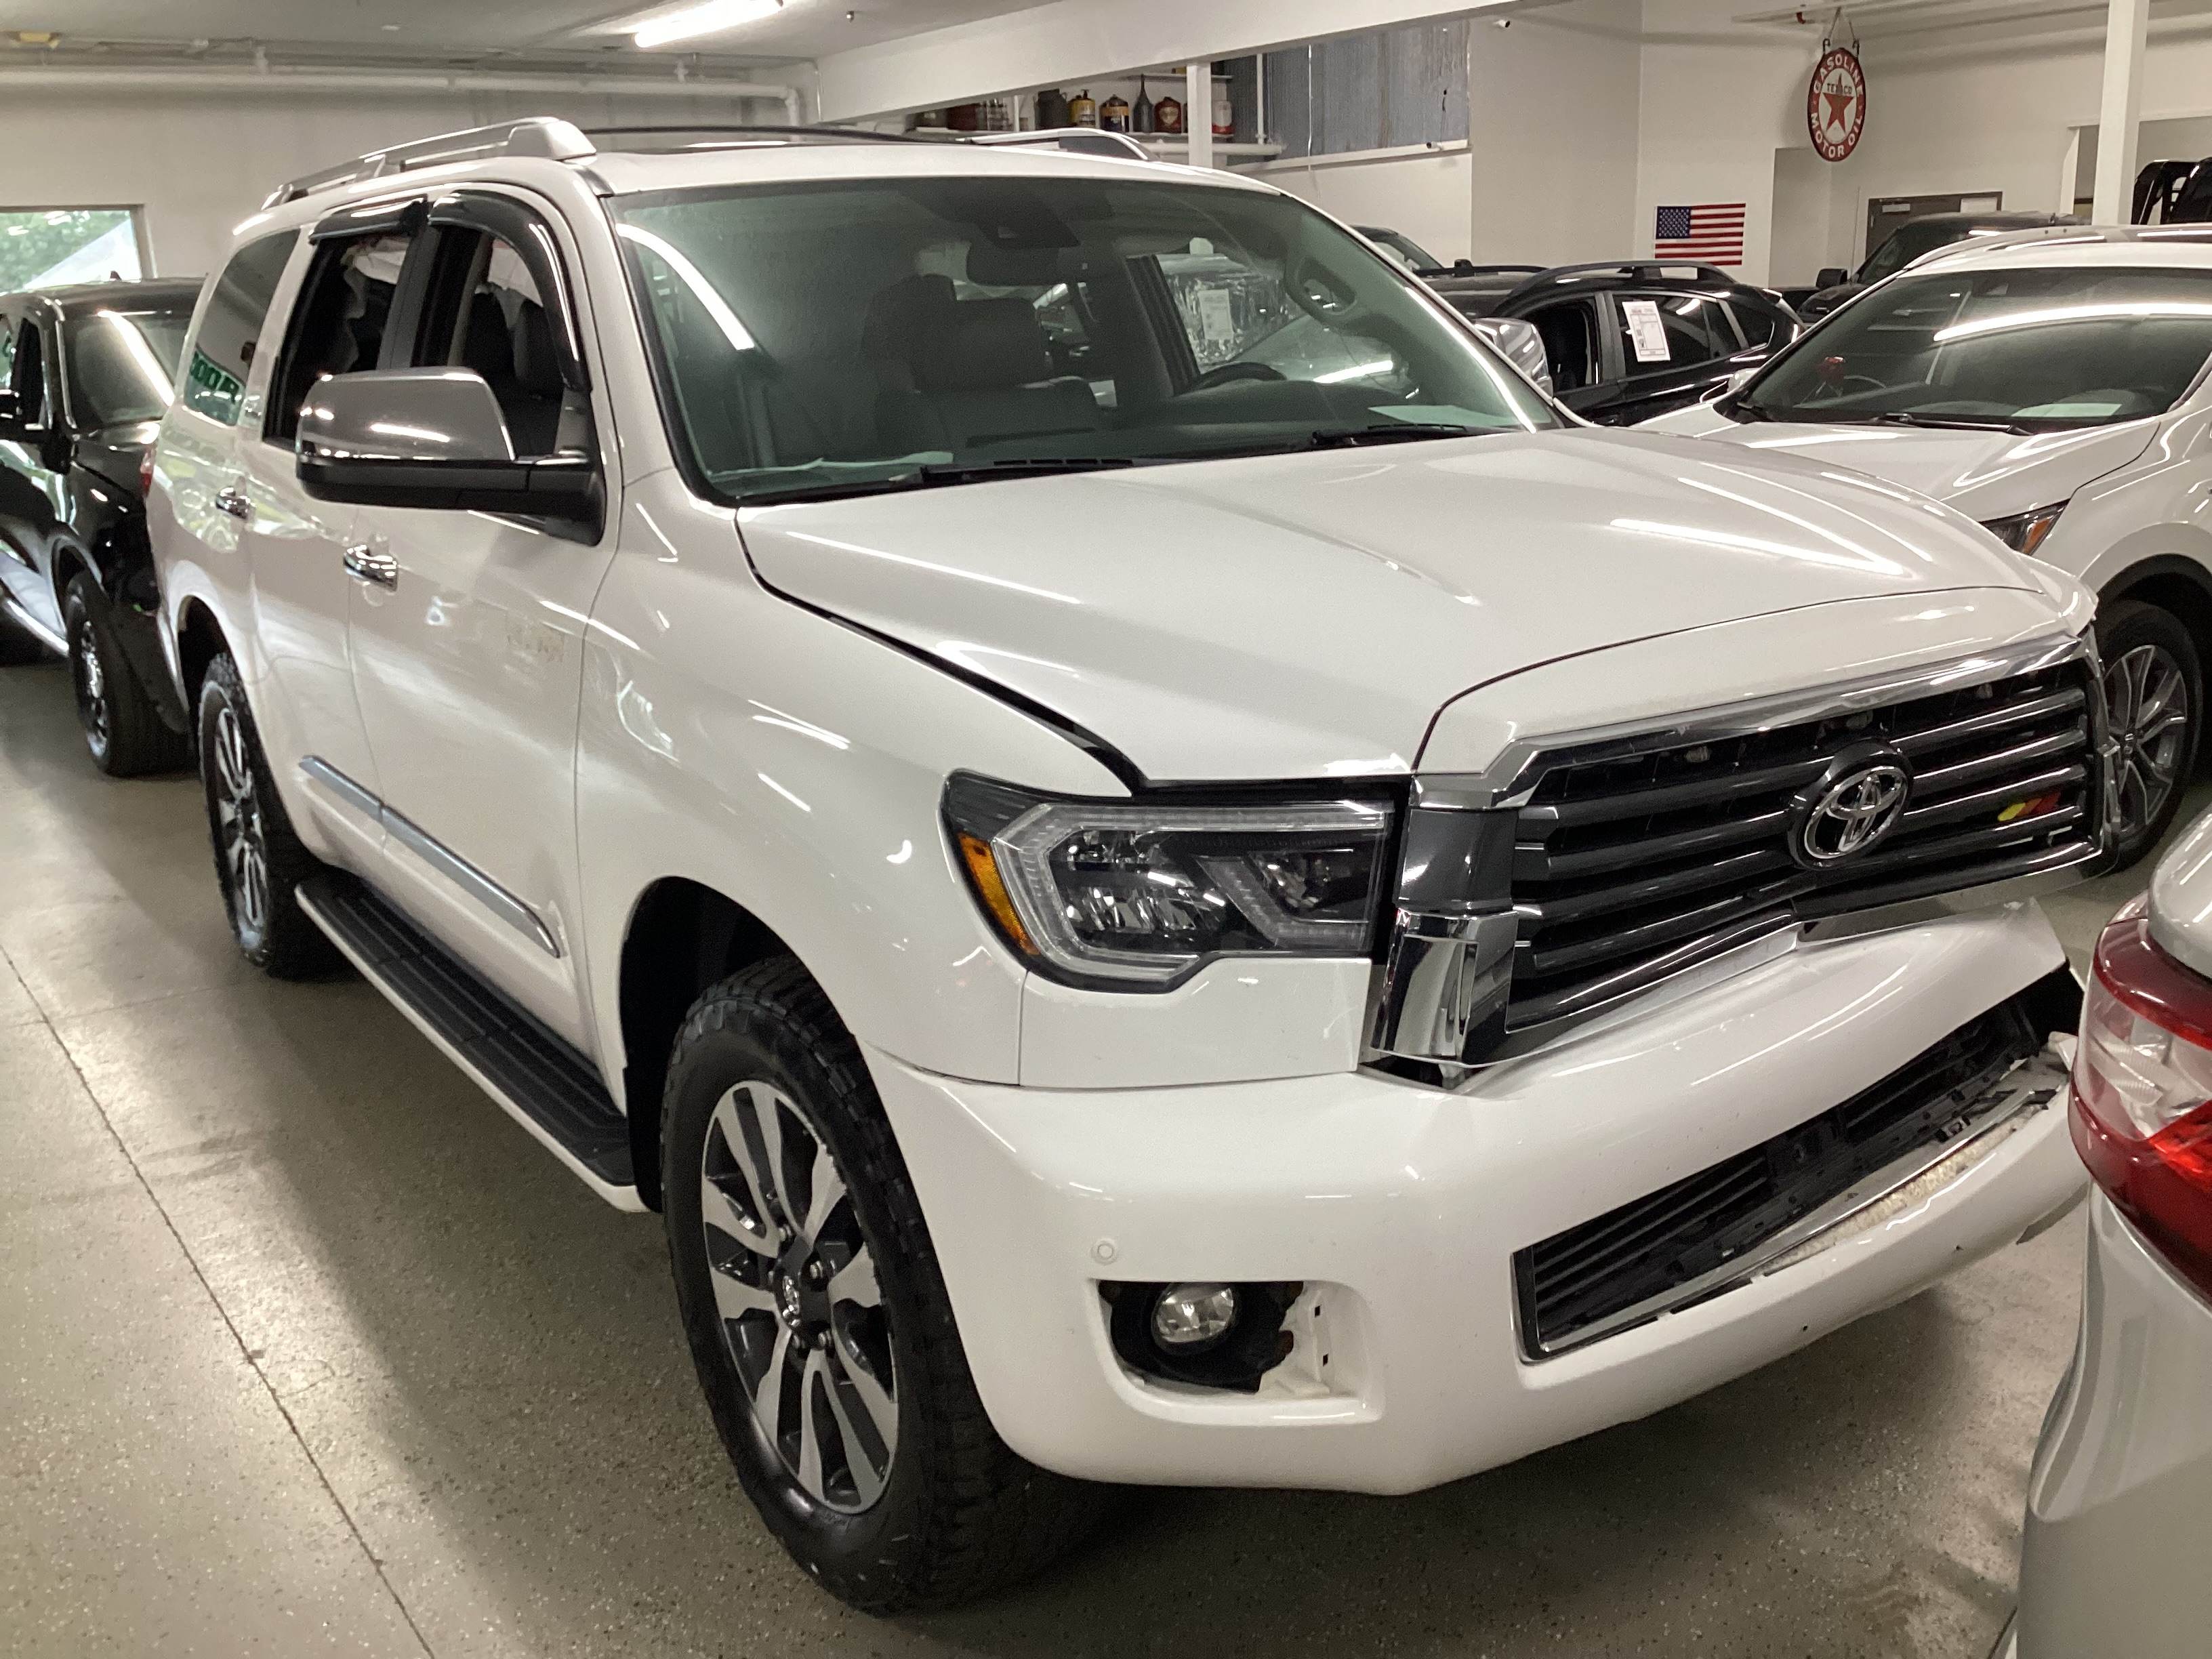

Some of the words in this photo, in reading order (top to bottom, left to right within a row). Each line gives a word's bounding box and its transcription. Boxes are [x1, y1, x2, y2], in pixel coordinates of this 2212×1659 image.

[1827, 83, 1852, 95] TECO
[1811, 112, 1845, 157] MOTOR
[1848, 115, 1862, 146] OIL
